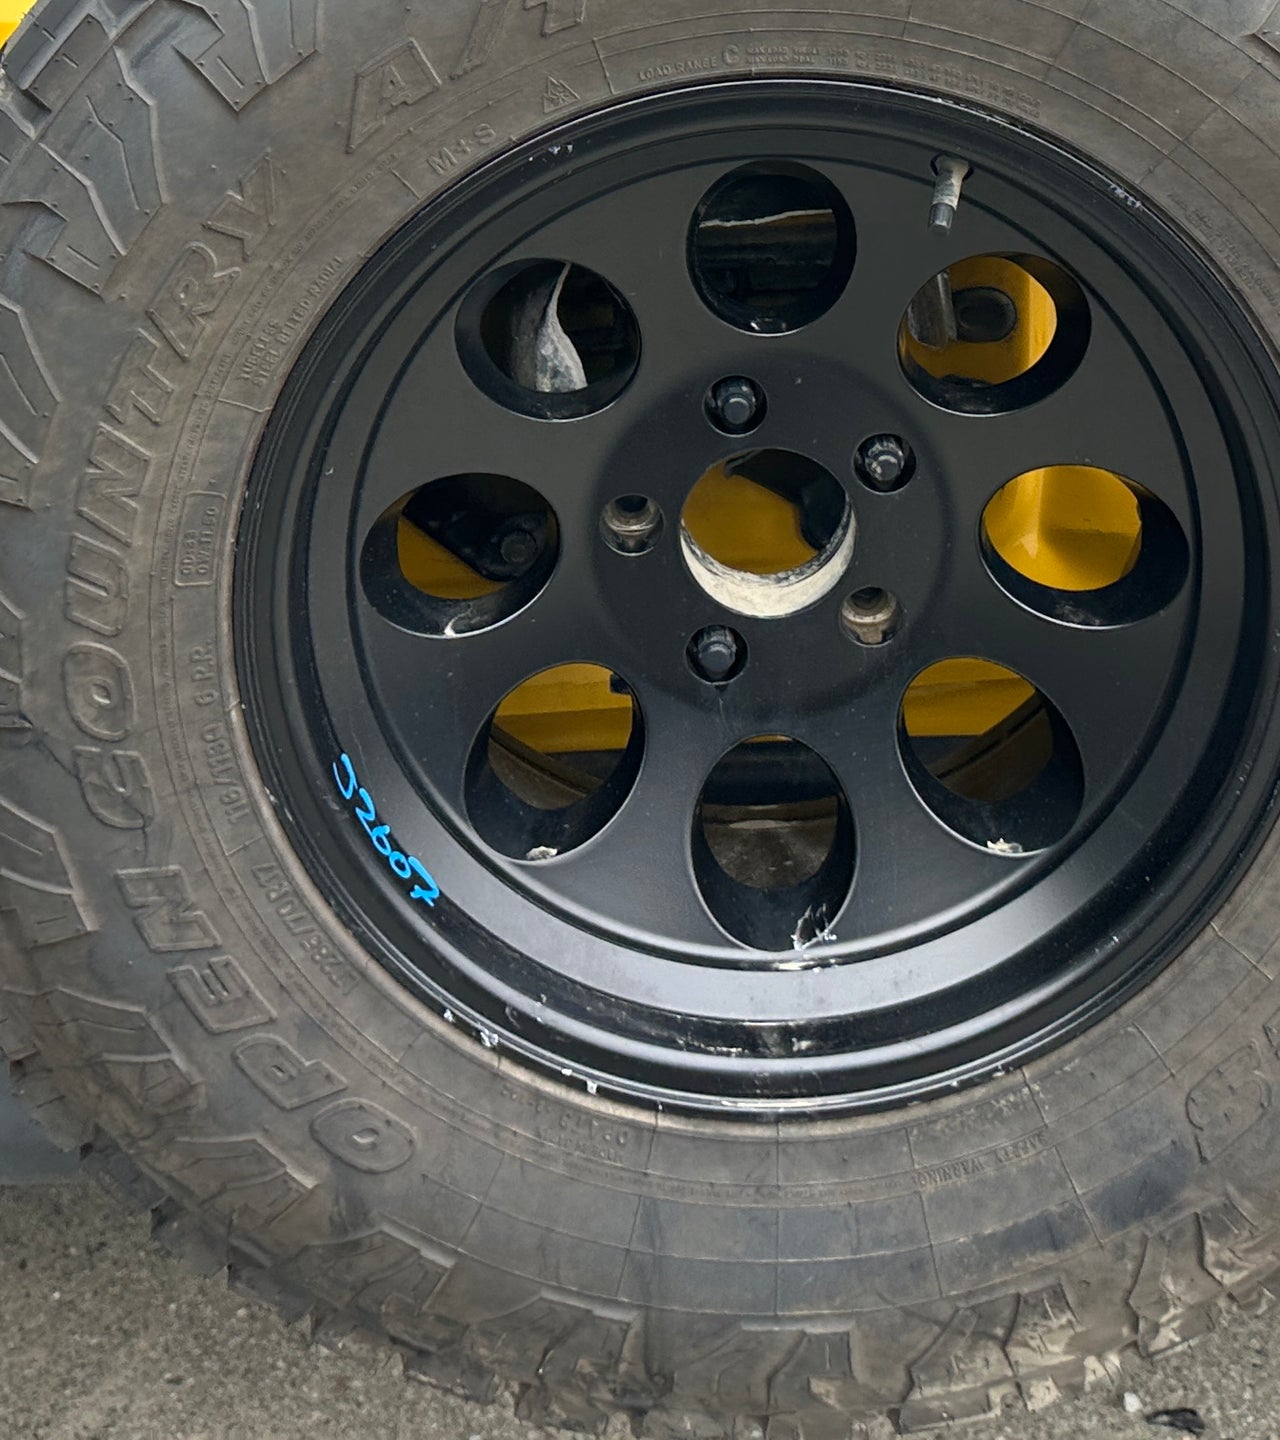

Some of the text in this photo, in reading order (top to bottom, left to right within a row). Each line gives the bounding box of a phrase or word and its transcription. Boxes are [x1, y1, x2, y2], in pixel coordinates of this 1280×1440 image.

[638, 62, 676, 83] LOAD
[677, 55, 717, 74] RANGE
[428, 122, 498, 176] M+S
[63, 157, 283, 826] COUNTRY
[332, 752, 441, 907] J2607
[120, 864, 416, 1174] OPEN
